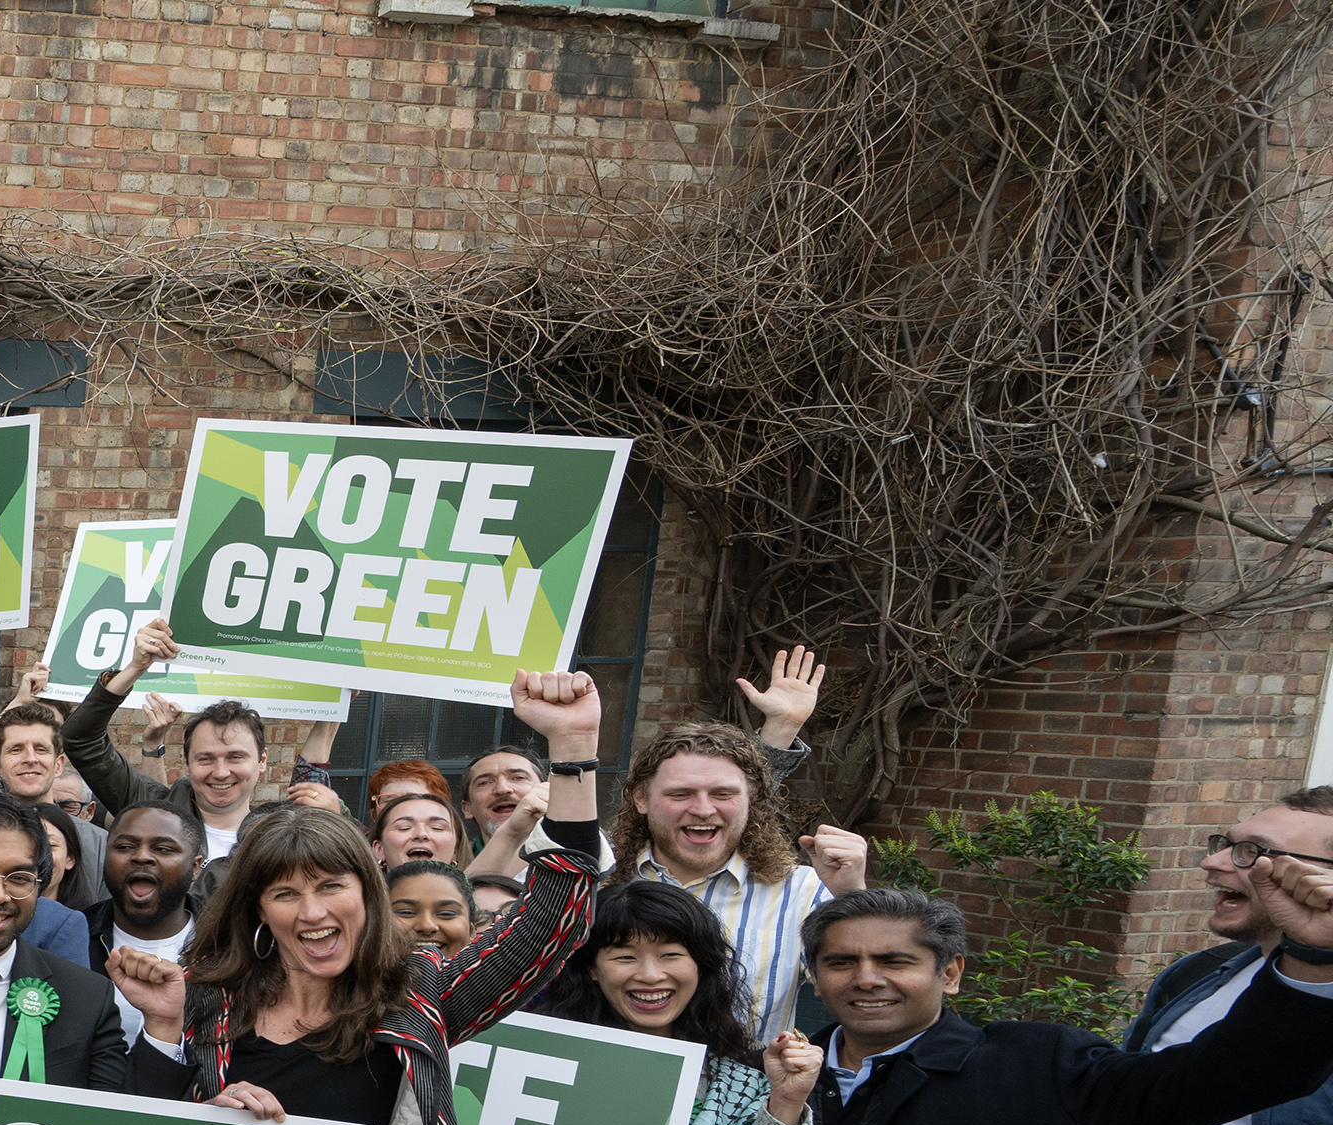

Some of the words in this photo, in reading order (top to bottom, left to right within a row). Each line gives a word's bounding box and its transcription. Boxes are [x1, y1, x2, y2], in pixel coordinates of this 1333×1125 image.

[264, 452, 535, 555] VOTE
[201, 543, 543, 656] GREEN
[179, 652, 203, 661] Green
[205, 656, 227, 666] Party
[265, 705, 337, 716] www.greenparty.org.uk
